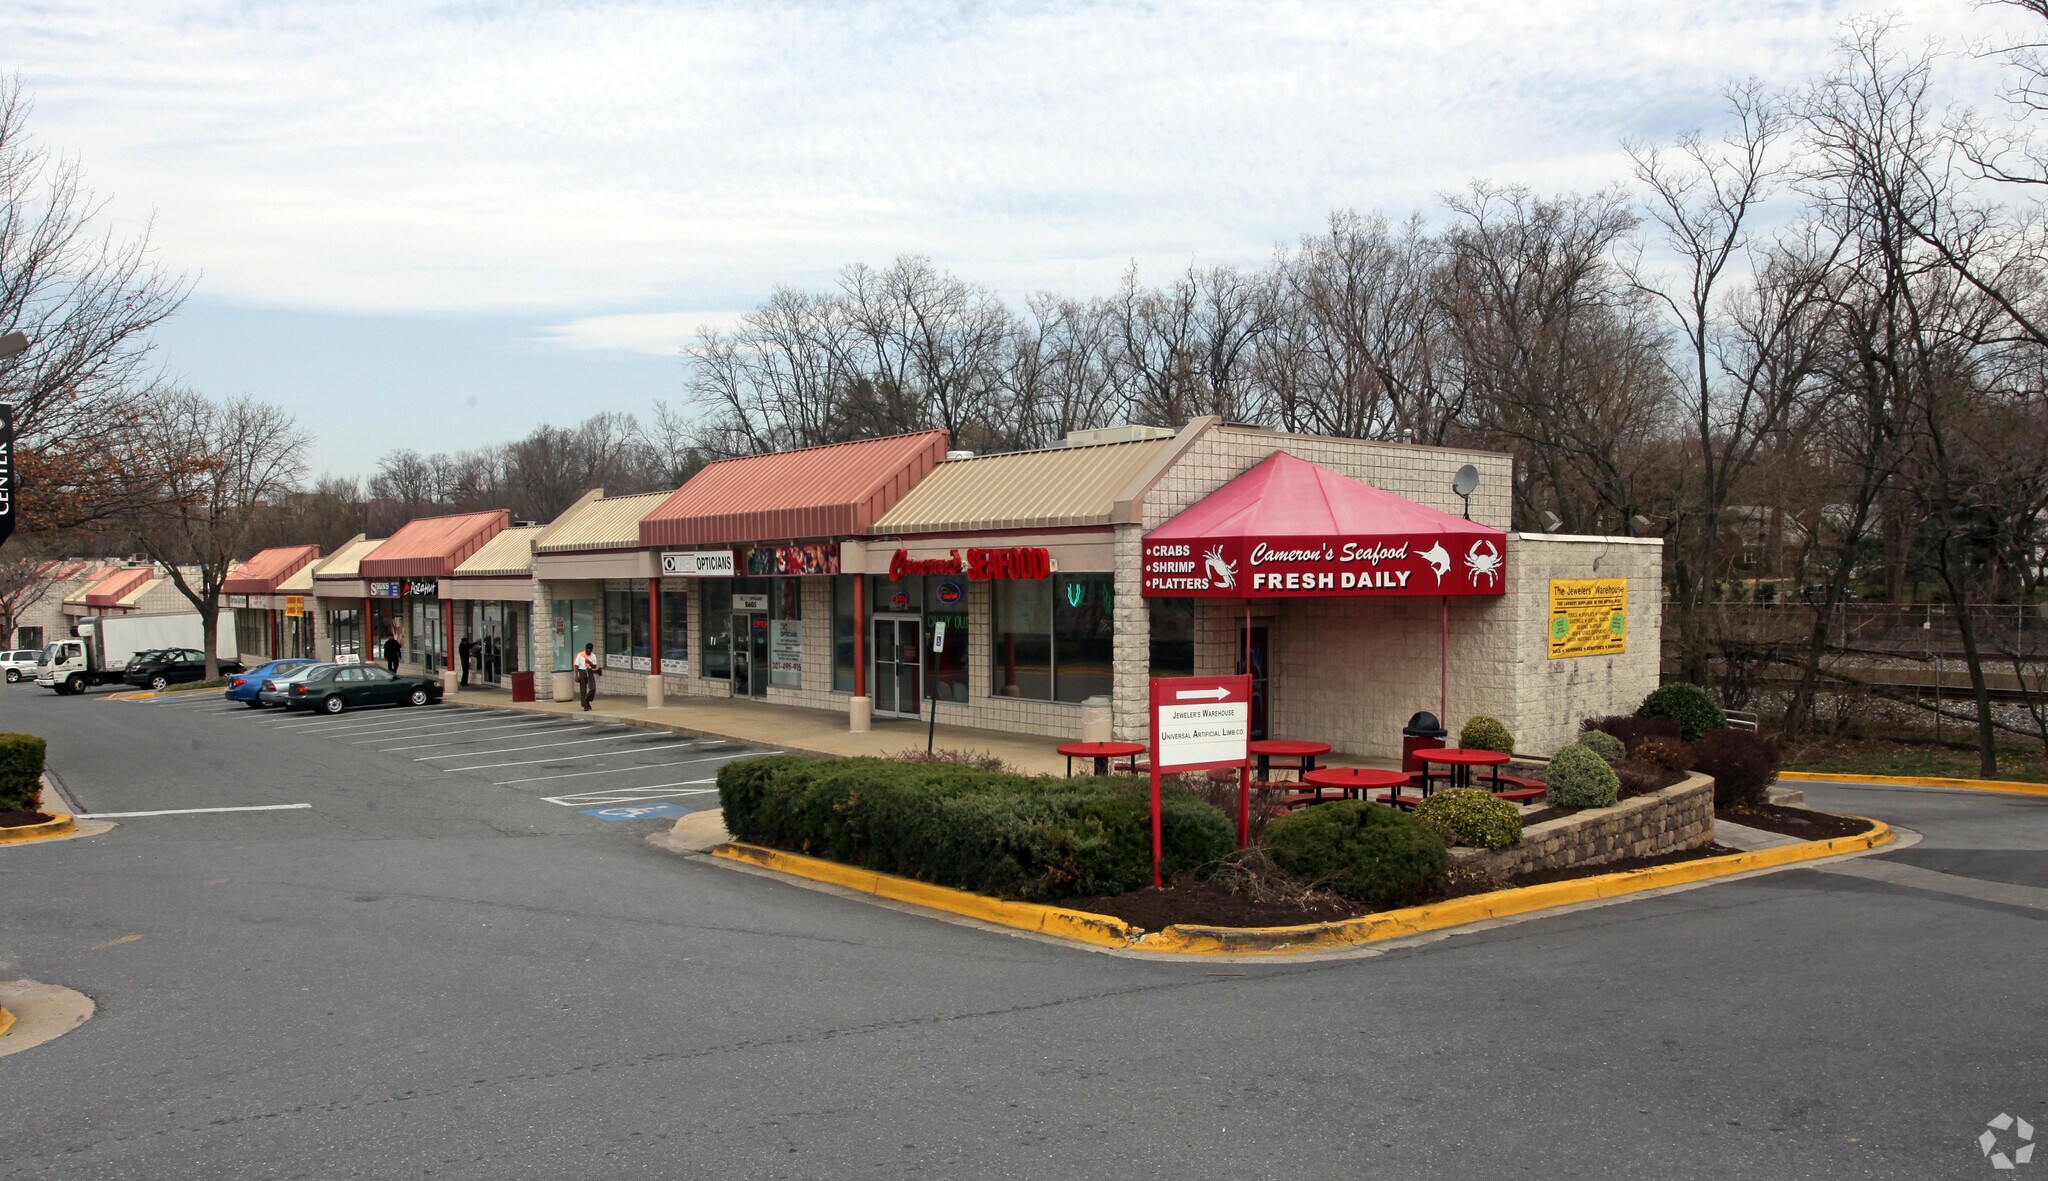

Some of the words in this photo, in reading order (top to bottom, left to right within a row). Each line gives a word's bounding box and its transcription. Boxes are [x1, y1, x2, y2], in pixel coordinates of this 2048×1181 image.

[1152, 545, 1190, 557] CRABS
[1250, 542, 1334, 566] Cameron's
[1340, 541, 1408, 566] Seafood
[696, 556, 731, 570] OPTICIANS
[967, 547, 1050, 580] SEAFOOD
[1152, 561, 1195, 573] SHRIMP
[1152, 578, 1209, 590] PLATTERS
[1253, 573, 1334, 589] FRESH
[1341, 571, 1411, 588] DAILY
[1554, 586, 1565, 595] The
[1595, 585, 1624, 594] Warehouse
[1202, 709, 1235, 718] WAREHOUSE
[1161, 732, 1191, 740] UNIVERSAL
[1193, 730, 1221, 738] ARTIFICIAL
[1222, 728, 1235, 736] LIMB
